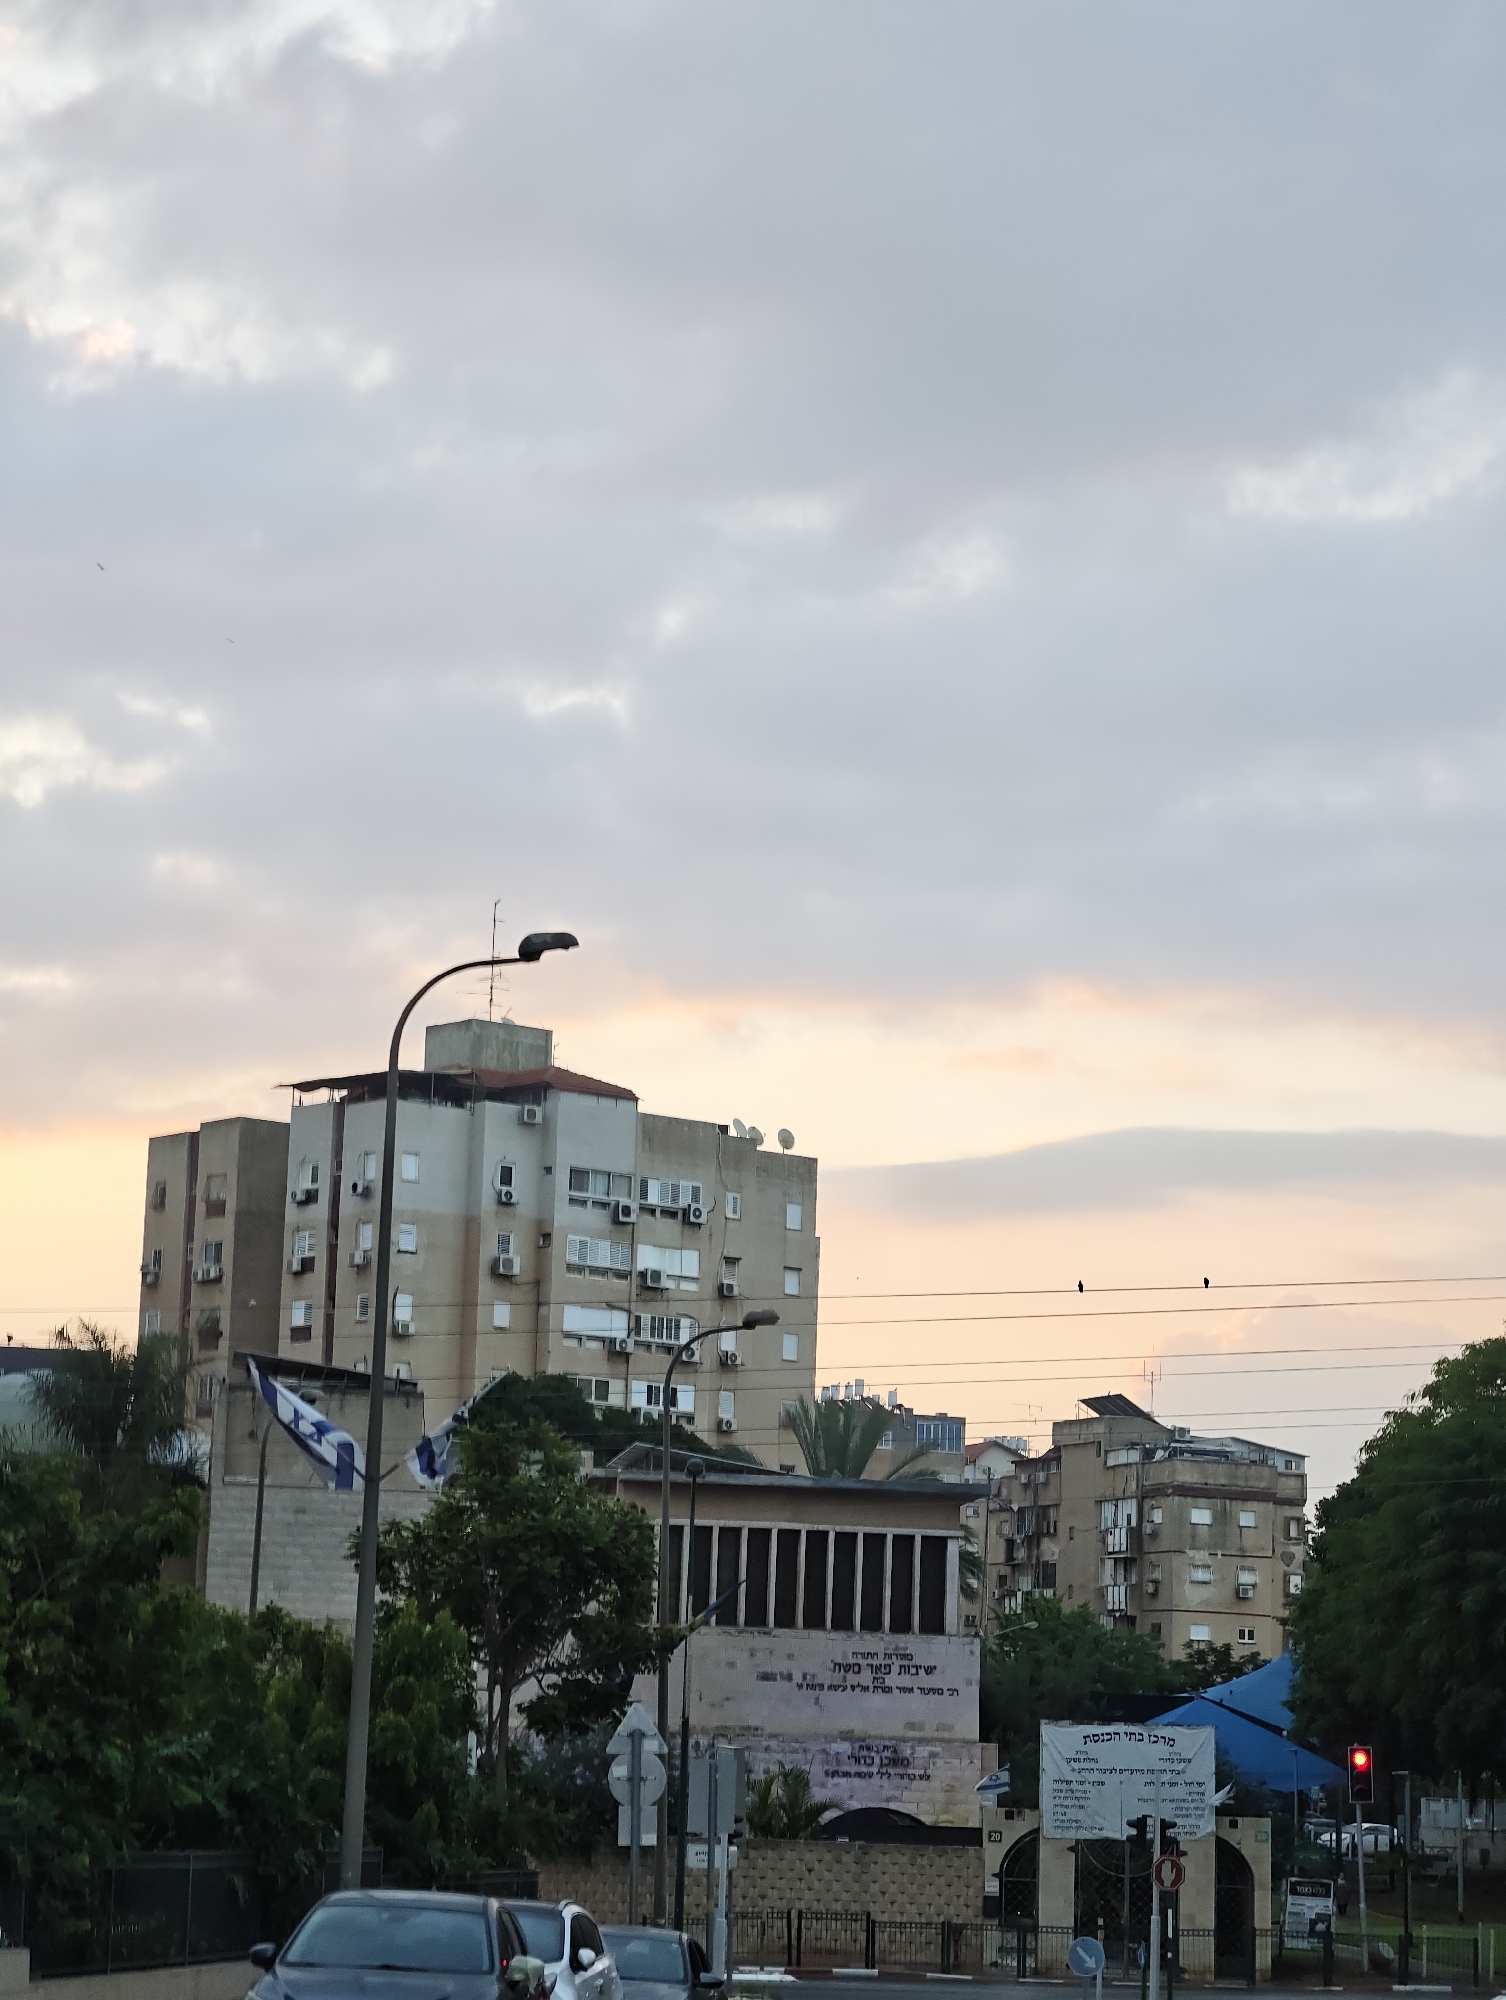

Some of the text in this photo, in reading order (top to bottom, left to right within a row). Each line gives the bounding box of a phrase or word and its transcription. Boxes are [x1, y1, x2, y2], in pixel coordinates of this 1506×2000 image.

[851, 1651, 914, 1661] מוסדות התורה
[898, 1664, 937, 1676] ישיבות
[872, 1676, 886, 1685] בית
[896, 1685, 914, 1694] אשר
[1082, 1732, 1176, 1748] מרכז בתי הכנסת
[847, 1755, 910, 1768] משכן כדורי
[1095, 1765, 1117, 1775] לציבור
[1168, 1768, 1181, 1776] בתי
[990, 1832, 1001, 1841] 20
